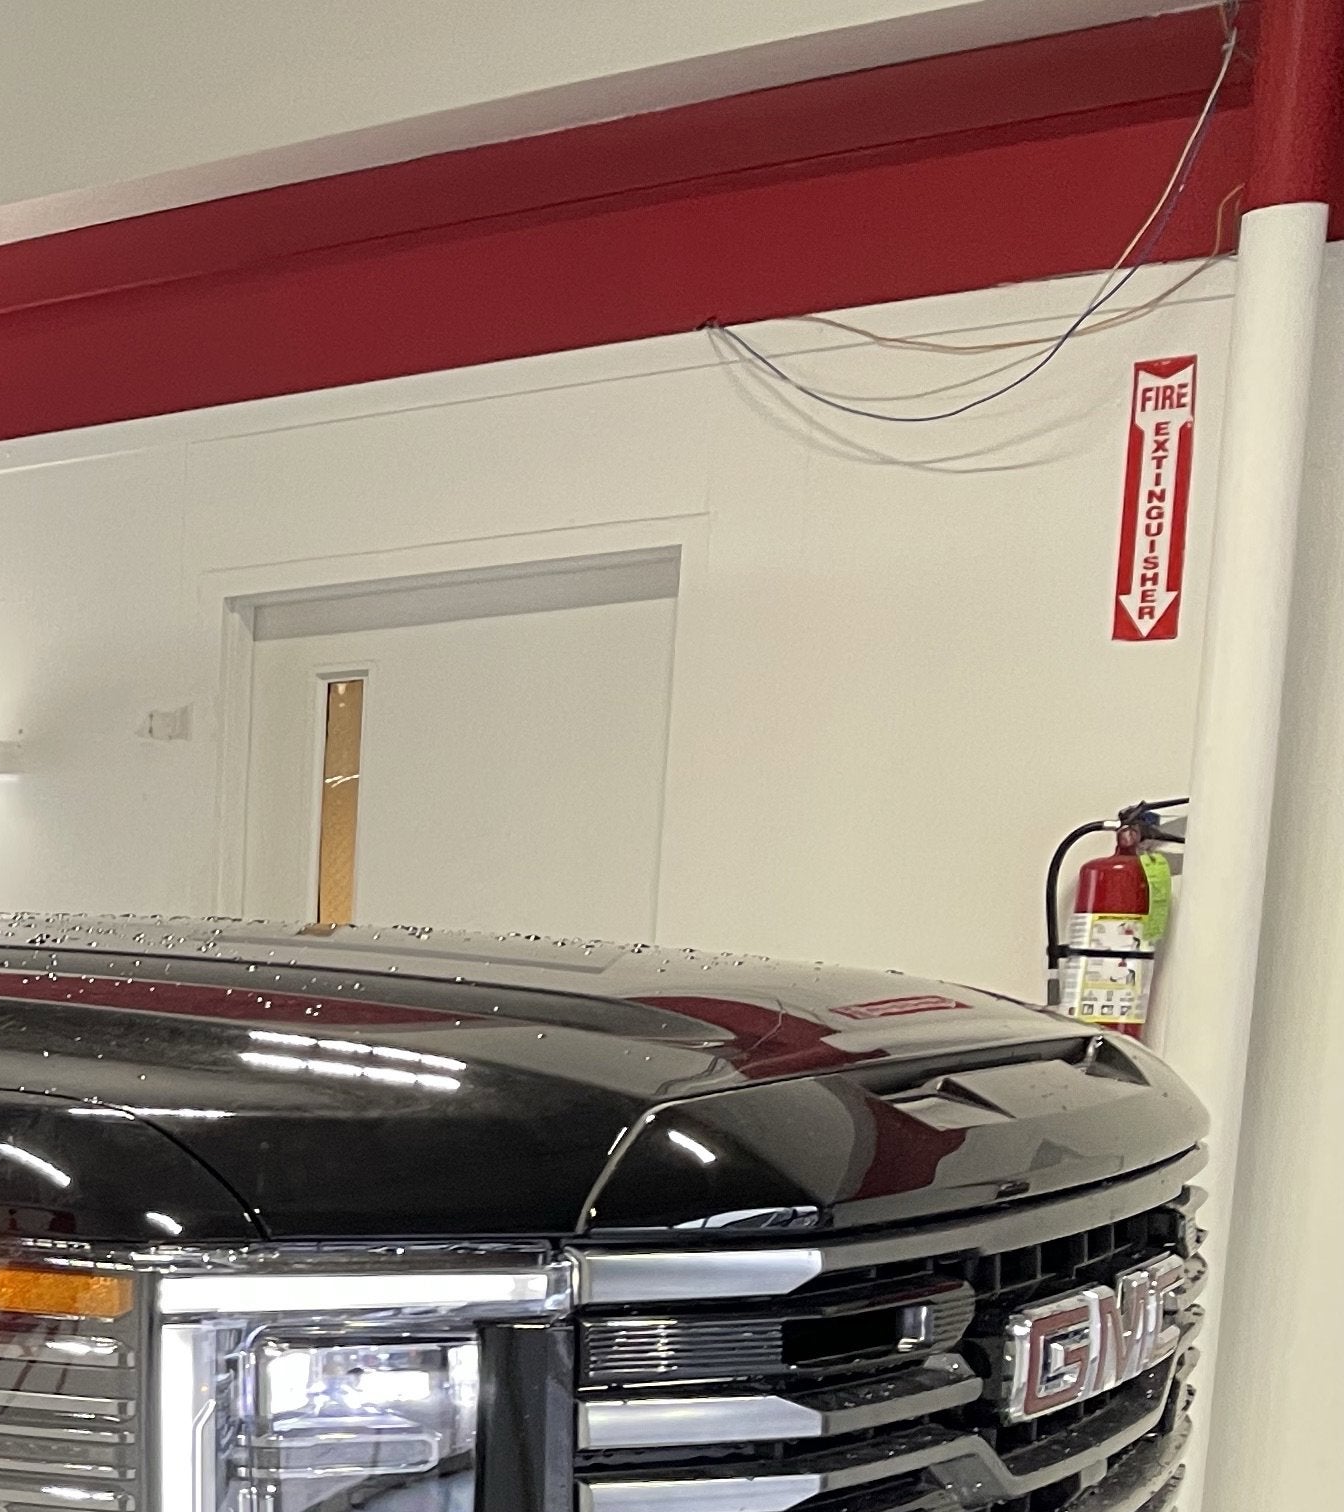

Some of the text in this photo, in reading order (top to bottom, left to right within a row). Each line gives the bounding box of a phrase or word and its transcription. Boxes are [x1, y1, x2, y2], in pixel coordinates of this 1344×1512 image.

[1140, 383, 1189, 412] FIRE
[1138, 421, 1171, 620] EXTINGUISHER
[1005, 1254, 1184, 1427] GMC
